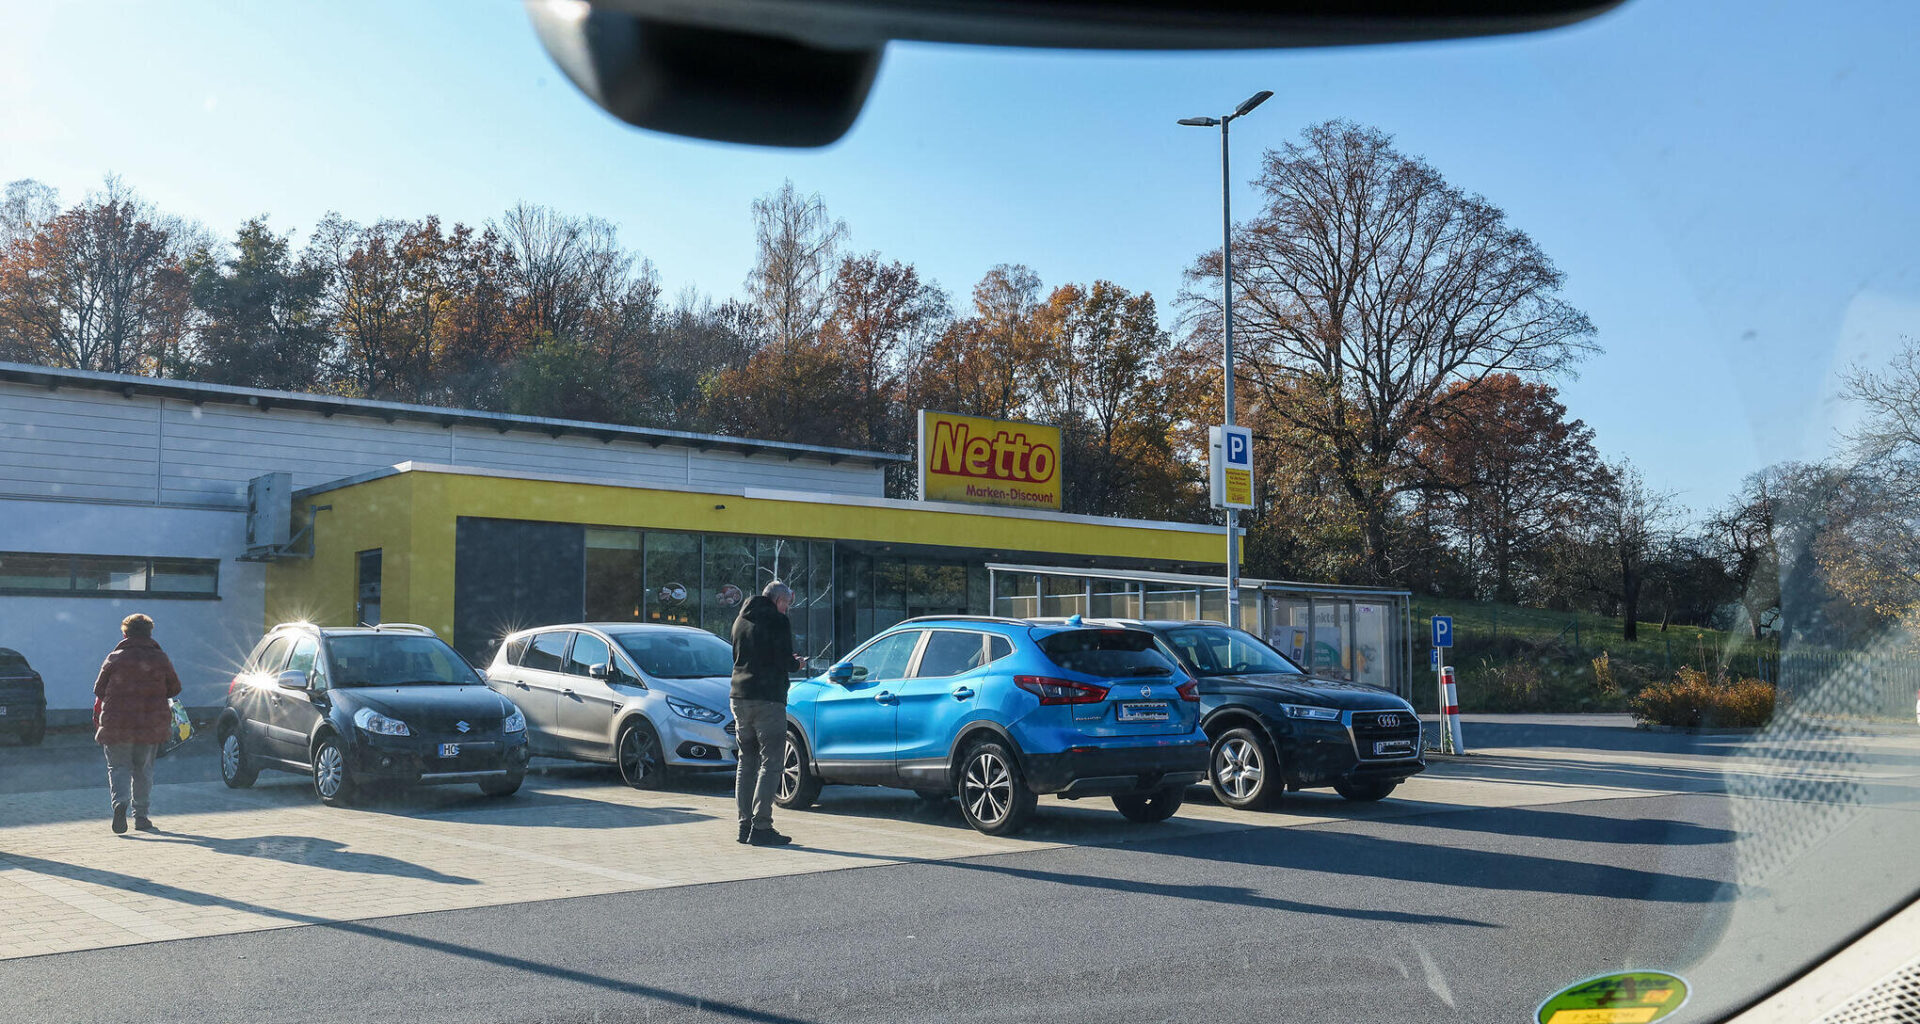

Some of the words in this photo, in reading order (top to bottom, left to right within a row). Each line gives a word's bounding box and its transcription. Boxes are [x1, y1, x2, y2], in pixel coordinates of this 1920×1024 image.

[930, 420, 1056, 484] Netto
[1231, 436, 1244, 461] P
[966, 484, 1054, 504] Marken-Discount
[1436, 620, 1448, 643] P
